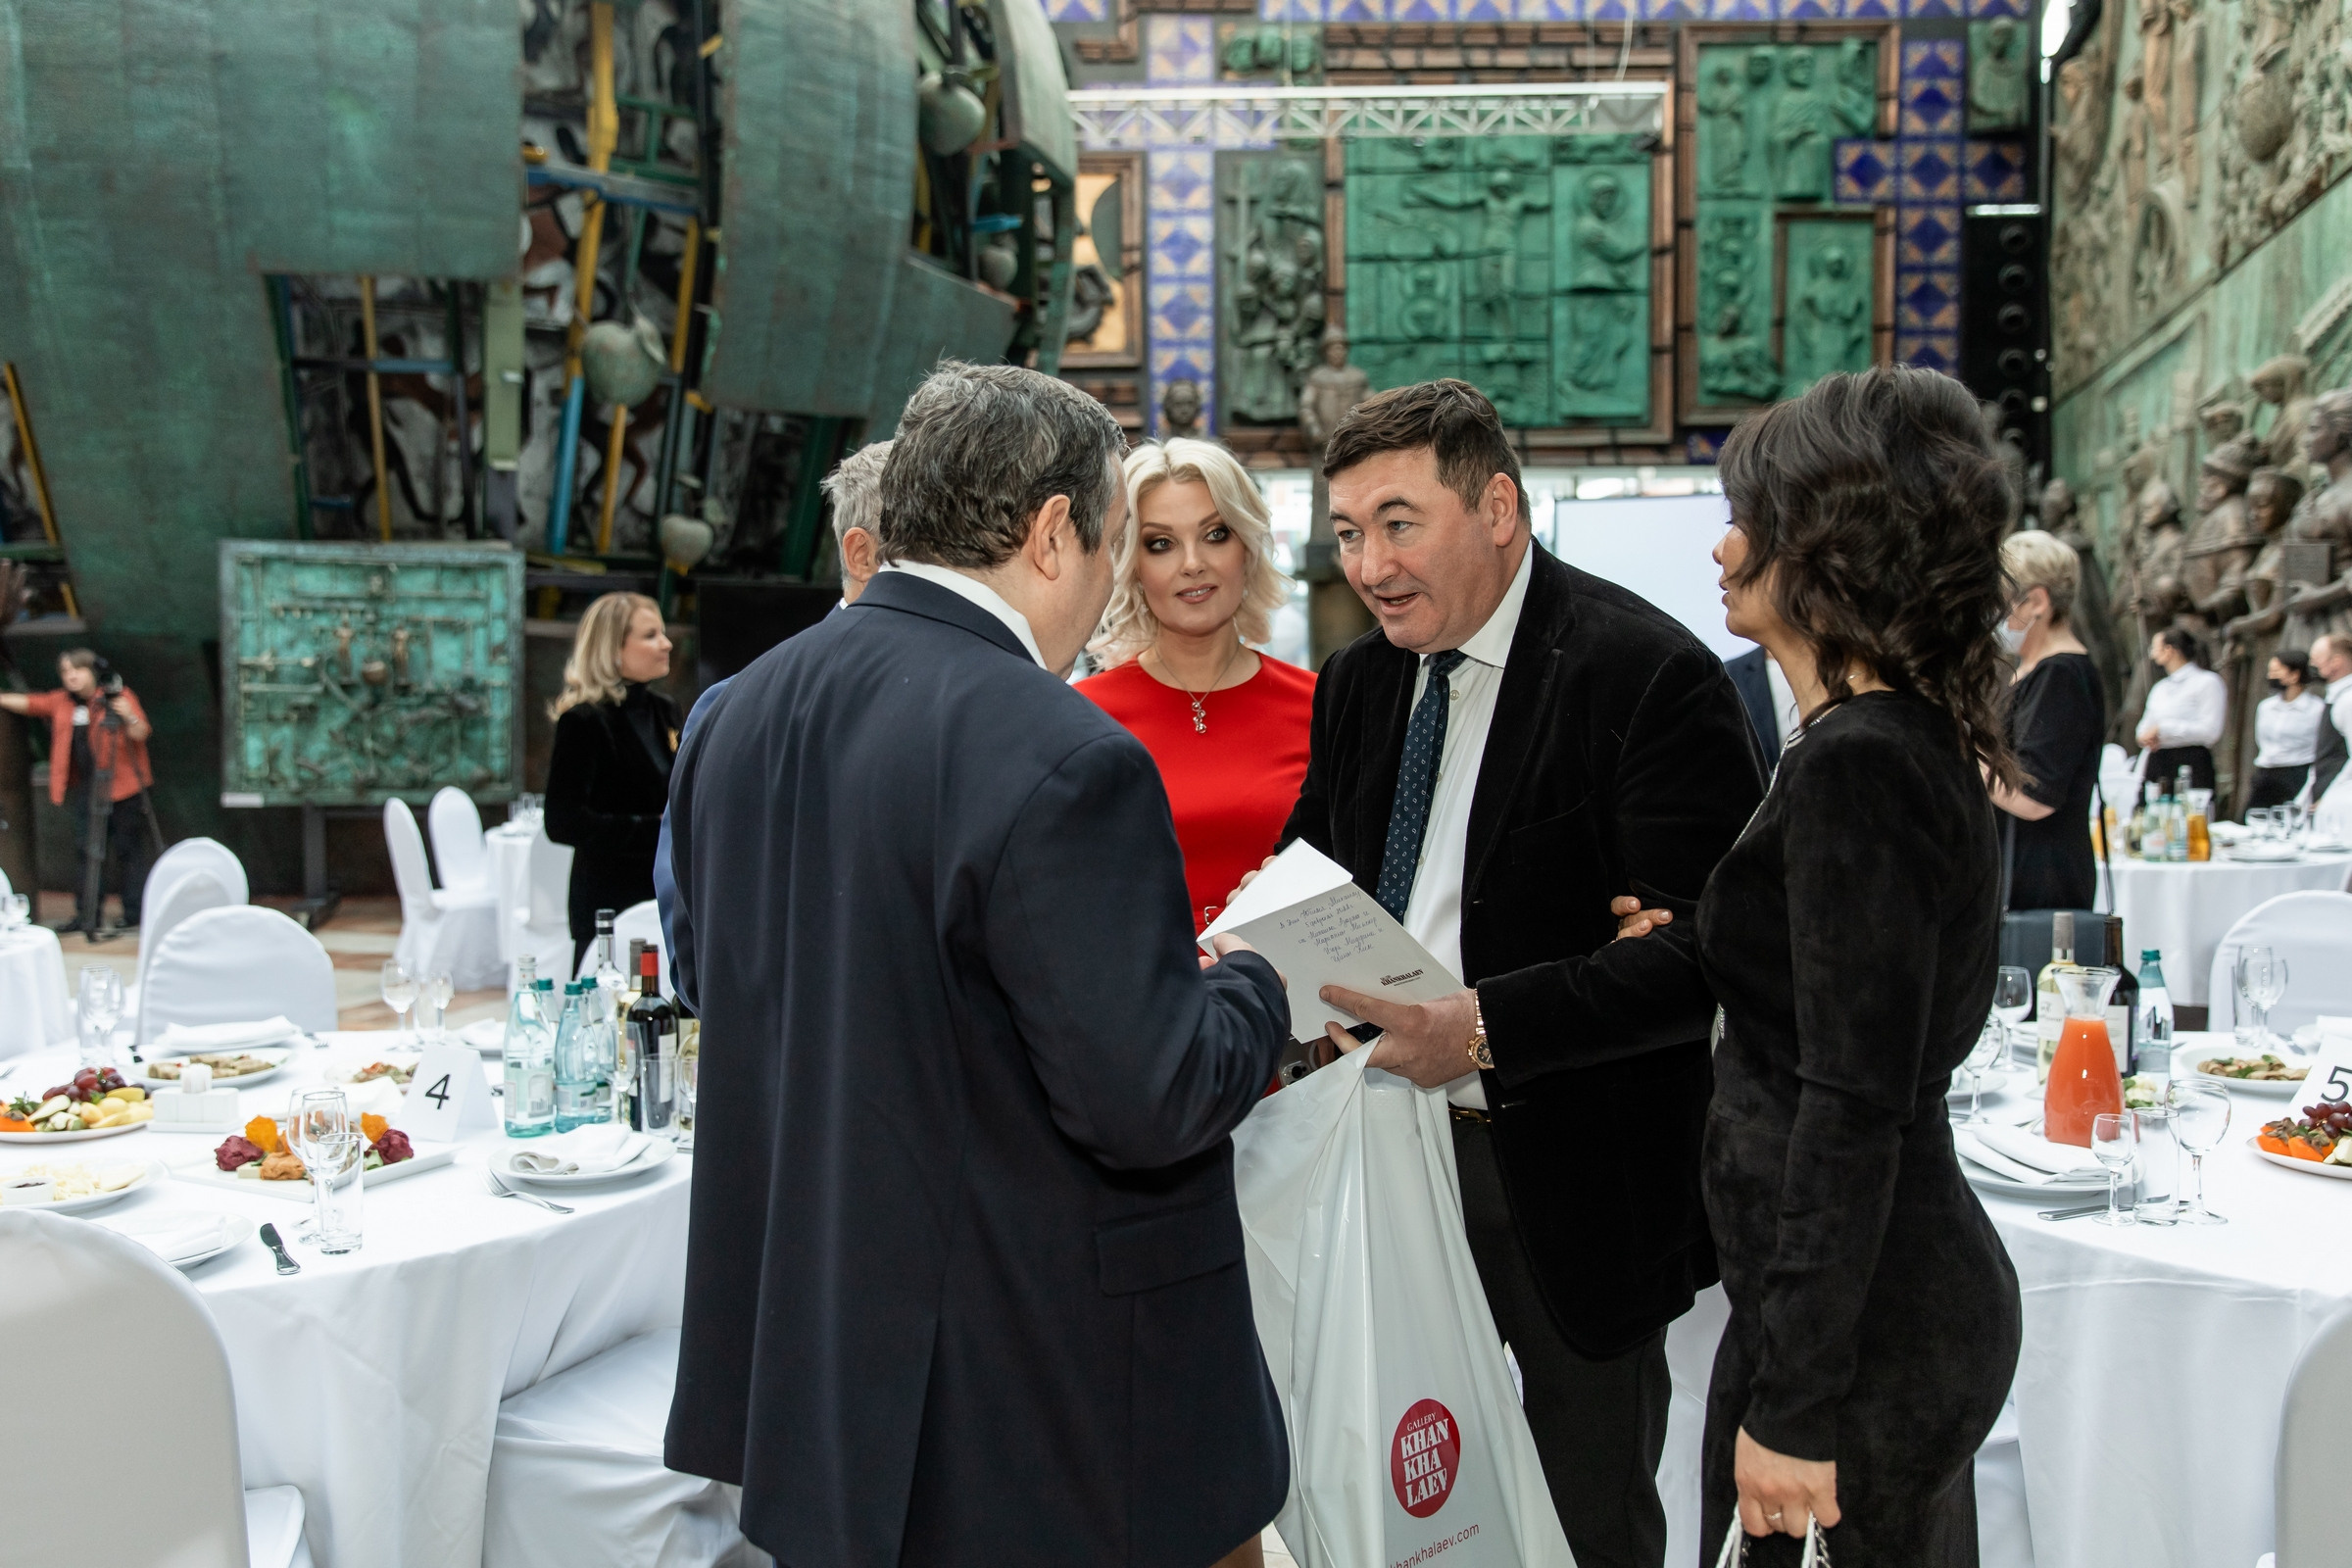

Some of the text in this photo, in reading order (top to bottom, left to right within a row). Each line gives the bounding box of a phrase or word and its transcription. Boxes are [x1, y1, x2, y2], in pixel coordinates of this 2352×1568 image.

[1380, 968, 1424, 986] KHANKHALAEV
[424, 1073, 451, 1110] 4
[2321, 1065, 2352, 1102] 5
[1400, 1418, 1449, 1459] KHAN
[1406, 1411, 1437, 1432] GALLERY
[1403, 1446, 1443, 1484] KHA
[1405, 1468, 1447, 1508] LAEV
